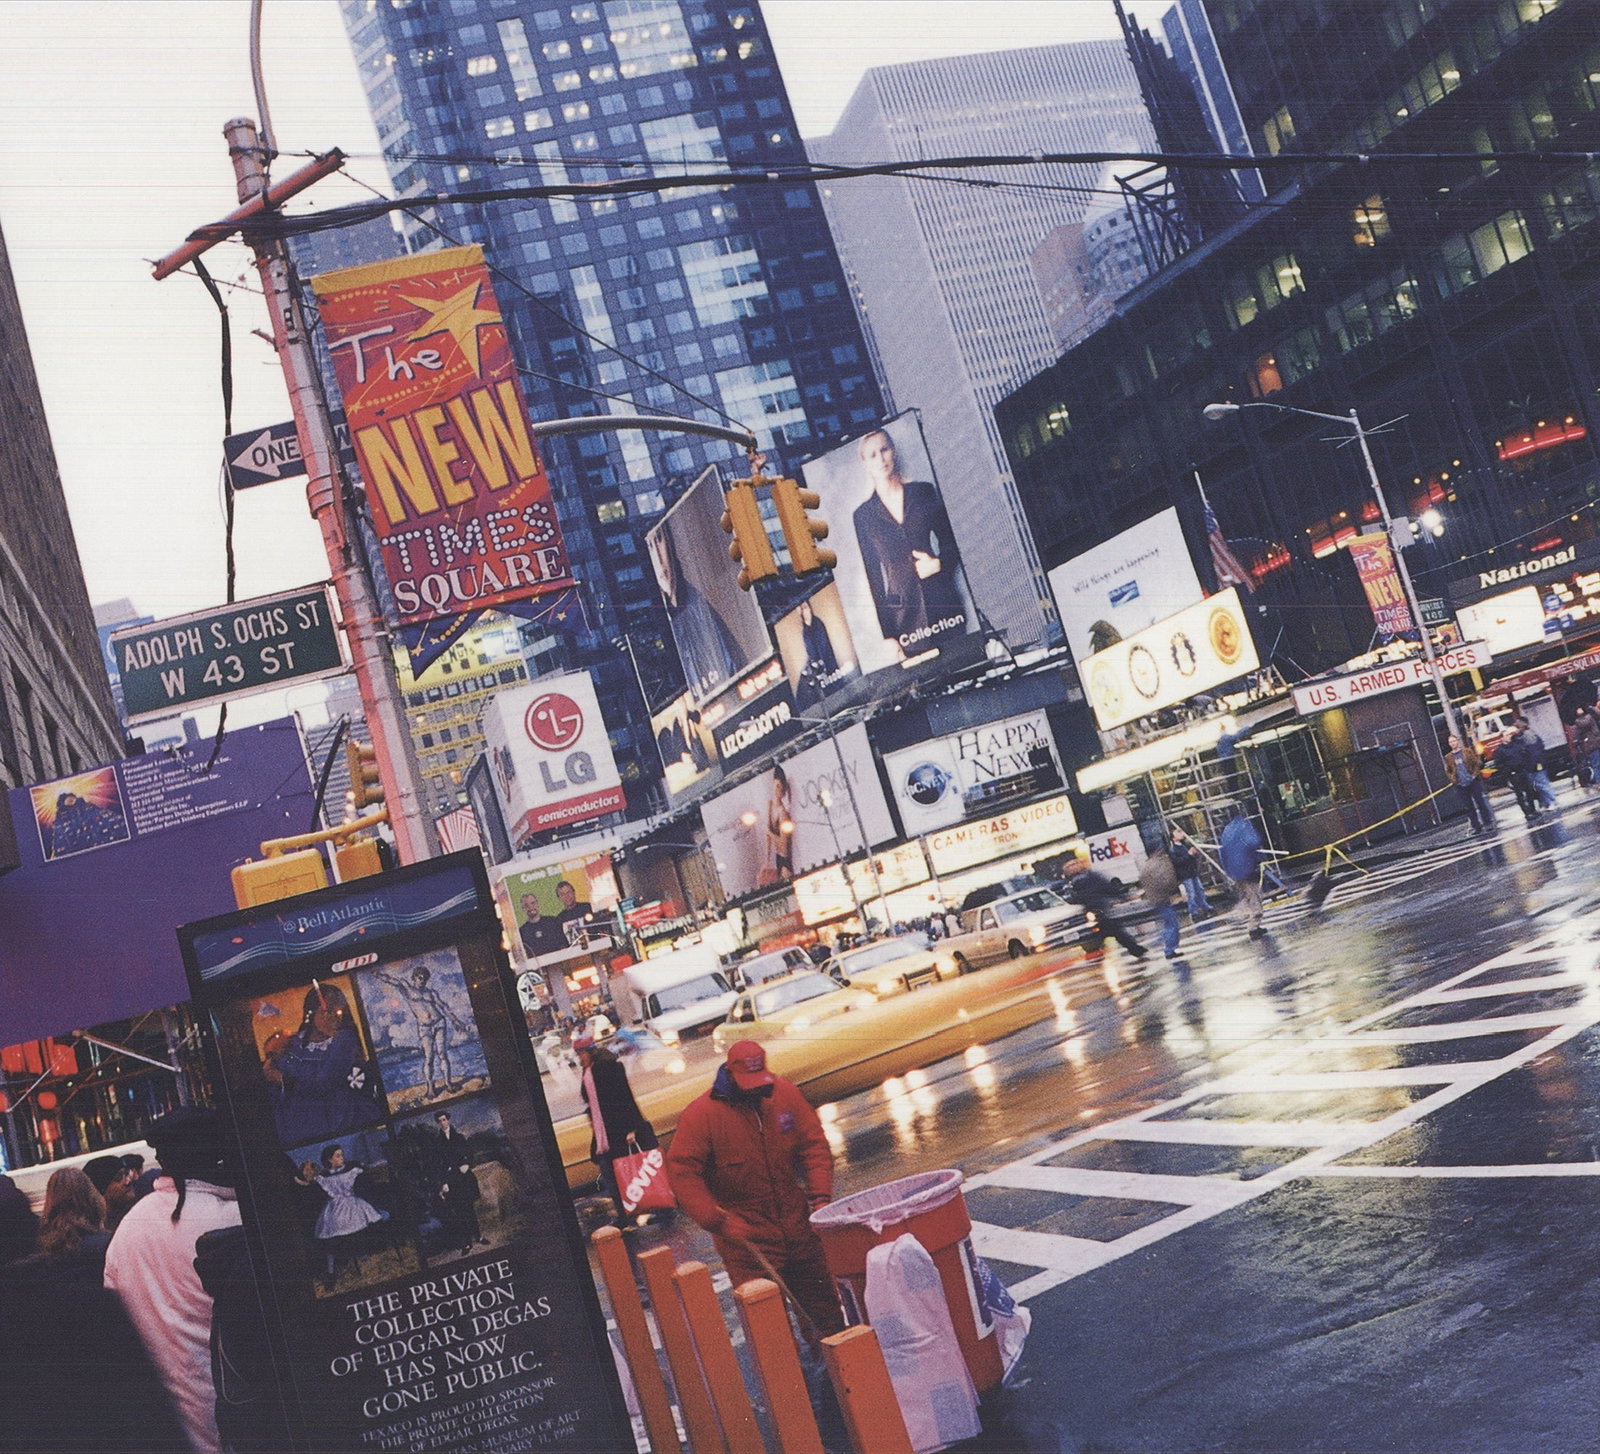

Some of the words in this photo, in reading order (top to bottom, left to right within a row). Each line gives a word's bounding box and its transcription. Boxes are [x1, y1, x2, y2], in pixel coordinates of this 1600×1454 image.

[327, 325, 443, 383] The
[252, 438, 301, 467] ONE
[356, 381, 543, 524] NEW
[381, 502, 556, 572] TIMES
[393, 546, 567, 615] SQUARE
[1364, 572, 1406, 609] NEW
[1479, 545, 1577, 589] National
[124, 628, 204, 673] ADOLPH
[210, 622, 232, 650] S.
[234, 608, 288, 644] OCHS
[295, 600, 321, 630] ST
[899, 614, 965, 647] Collection
[1374, 606, 1410, 621] TIMES
[1378, 617, 1414, 633] SQUARE
[160, 667, 186, 699] W
[202, 655, 245, 687] 43
[260, 641, 296, 674] ST
[1308, 685, 1341, 706] U.S.
[1349, 667, 1406, 697] ARMED
[1413, 649, 1476, 678] FORCES
[1573, 652, 1600, 671] SQUAR
[957, 719, 1041, 760] HAPPY
[538, 751, 597, 793] LG
[799, 760, 859, 809] JOCKY
[972, 751, 1033, 783] NEW
[537, 794, 620, 824] semiconductors
[933, 818, 1009, 850] CAMERAS
[1020, 801, 1065, 823] VIDEO
[1089, 836, 1130, 863] FedEx
[296, 911, 327, 931] Bell
[329, 897, 386, 922] Atlantic
[346, 1292, 402, 1322] THE
[409, 1259, 513, 1305] PRIVATE
[355, 1282, 516, 1345] COLLECTION
[330, 1352, 364, 1377] OF
[373, 1325, 464, 1365] EDGAR
[472, 1296, 552, 1337] DEGAS
[384, 1356, 436, 1387] HAS
[445, 1334, 507, 1370] NOW
[363, 1381, 438, 1418] GONE
[446, 1351, 543, 1394] PUBLIC.
[361, 1421, 413, 1443] TEXACO
[416, 1414, 428, 1426] IS
[431, 1401, 475, 1423] PROUD
[479, 1395, 495, 1408] TO
[499, 1376, 557, 1401] SPONSOR
[380, 1436, 404, 1450] THE
[408, 1419, 460, 1442] PRIVATE
[463, 1393, 544, 1424] COLLECTION
[481, 1425, 536, 1447] MUSEUM
[538, 1420, 553, 1431] OF
[557, 1409, 582, 1423] ART
[410, 1441, 425, 1453] OF
[431, 1427, 474, 1448] EDGAR
